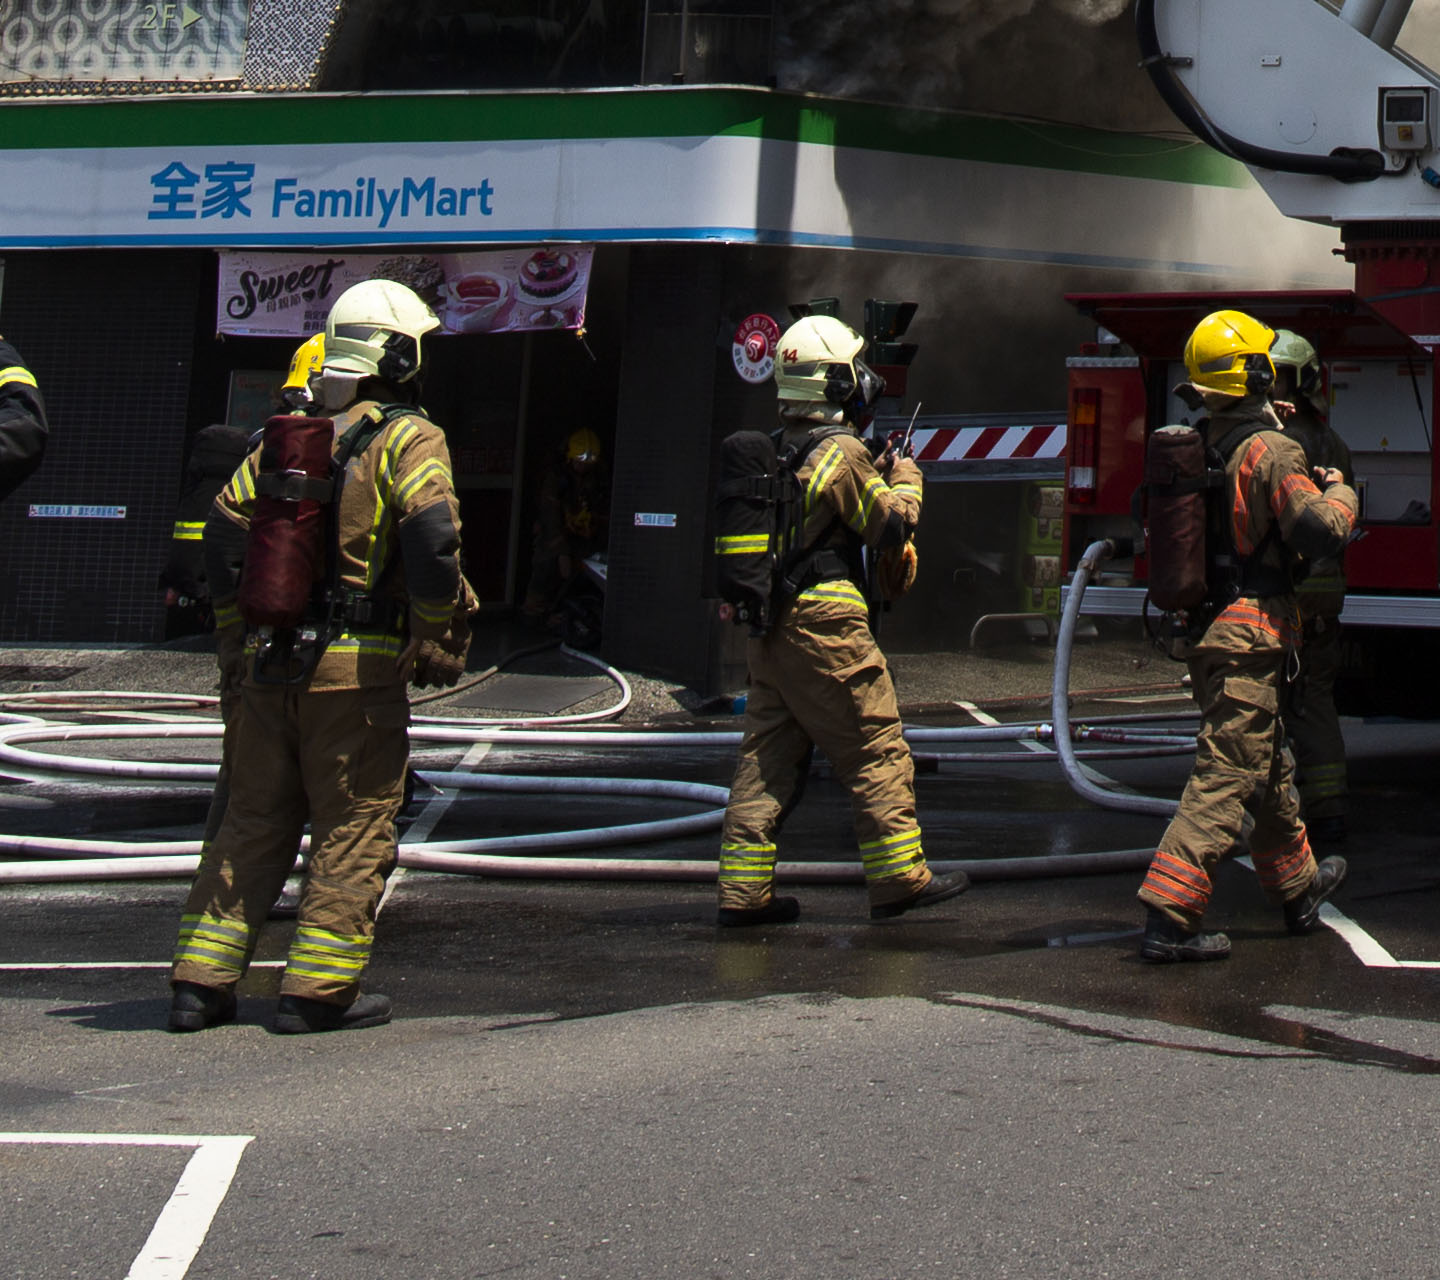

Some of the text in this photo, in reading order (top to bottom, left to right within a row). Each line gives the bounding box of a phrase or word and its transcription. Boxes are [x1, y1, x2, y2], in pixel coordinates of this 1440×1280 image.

[143, 4, 177, 30] 2F
[148, 161, 494, 228] 全家 FamilyMart
[227, 257, 345, 320] Sweet
[782, 348, 799, 364] 14
